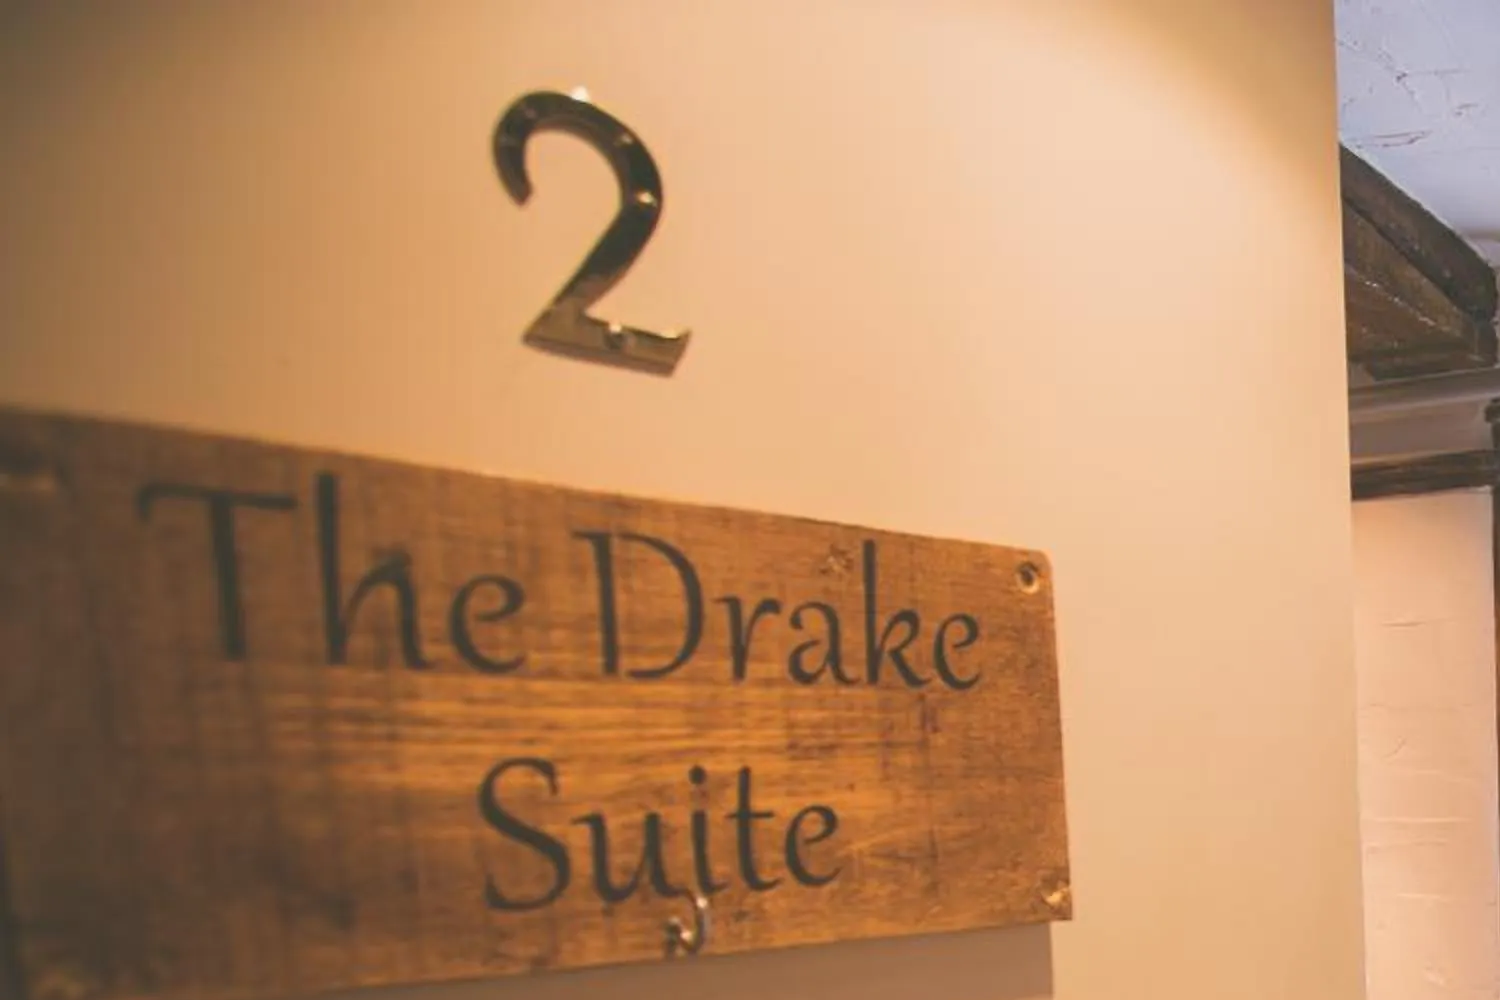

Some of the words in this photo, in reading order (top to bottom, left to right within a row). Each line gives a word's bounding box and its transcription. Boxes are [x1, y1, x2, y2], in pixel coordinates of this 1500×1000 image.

[490, 89, 693, 378] 2
[136, 472, 529, 673] The
[574, 529, 982, 692] Drake
[477, 756, 843, 913] Suite
